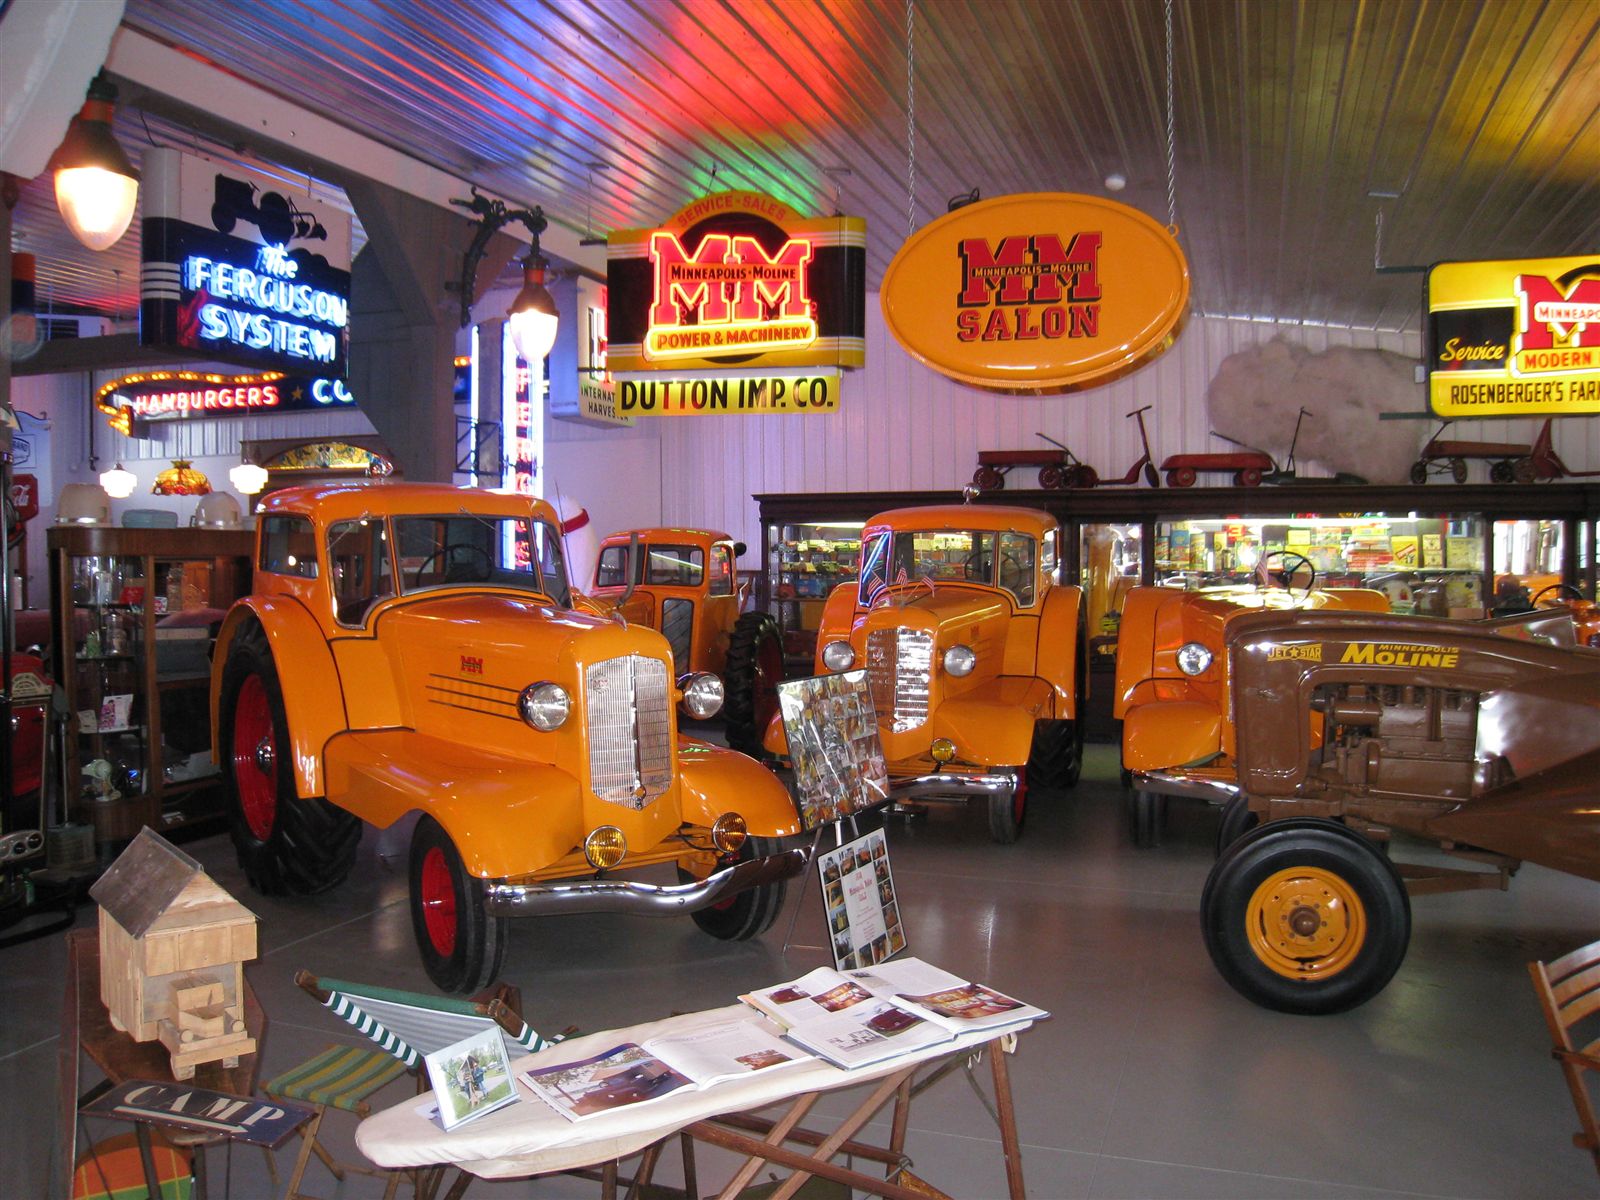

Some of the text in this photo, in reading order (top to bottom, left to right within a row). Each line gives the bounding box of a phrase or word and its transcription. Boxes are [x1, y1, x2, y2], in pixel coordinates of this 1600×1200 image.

[677, 195, 786, 227] SERVICE SALES
[255, 243, 299, 279] The
[957, 231, 1103, 308] MM
[184, 256, 348, 328] FERGUSON
[198, 303, 336, 364] SYSTEM
[657, 326, 810, 349] POWER & MACHINERY
[957, 304, 1100, 343] SALON
[1440, 337, 1505, 362] Service
[1525, 351, 1592, 370] MODERN
[134, 385, 279, 415] HAMBURGERS
[620, 377, 834, 411] DUTTON IMP. CO.
[1451, 381, 1563, 405] ROSENBERGER'S
[588, 401, 628, 421] HARVES
[1267, 646, 1321, 659] JET STAR
[1340, 643, 1458, 668] MOLINE
[1378, 644, 1459, 653] MINNEAPOLIS
[124, 1085, 285, 1126] CAMP
